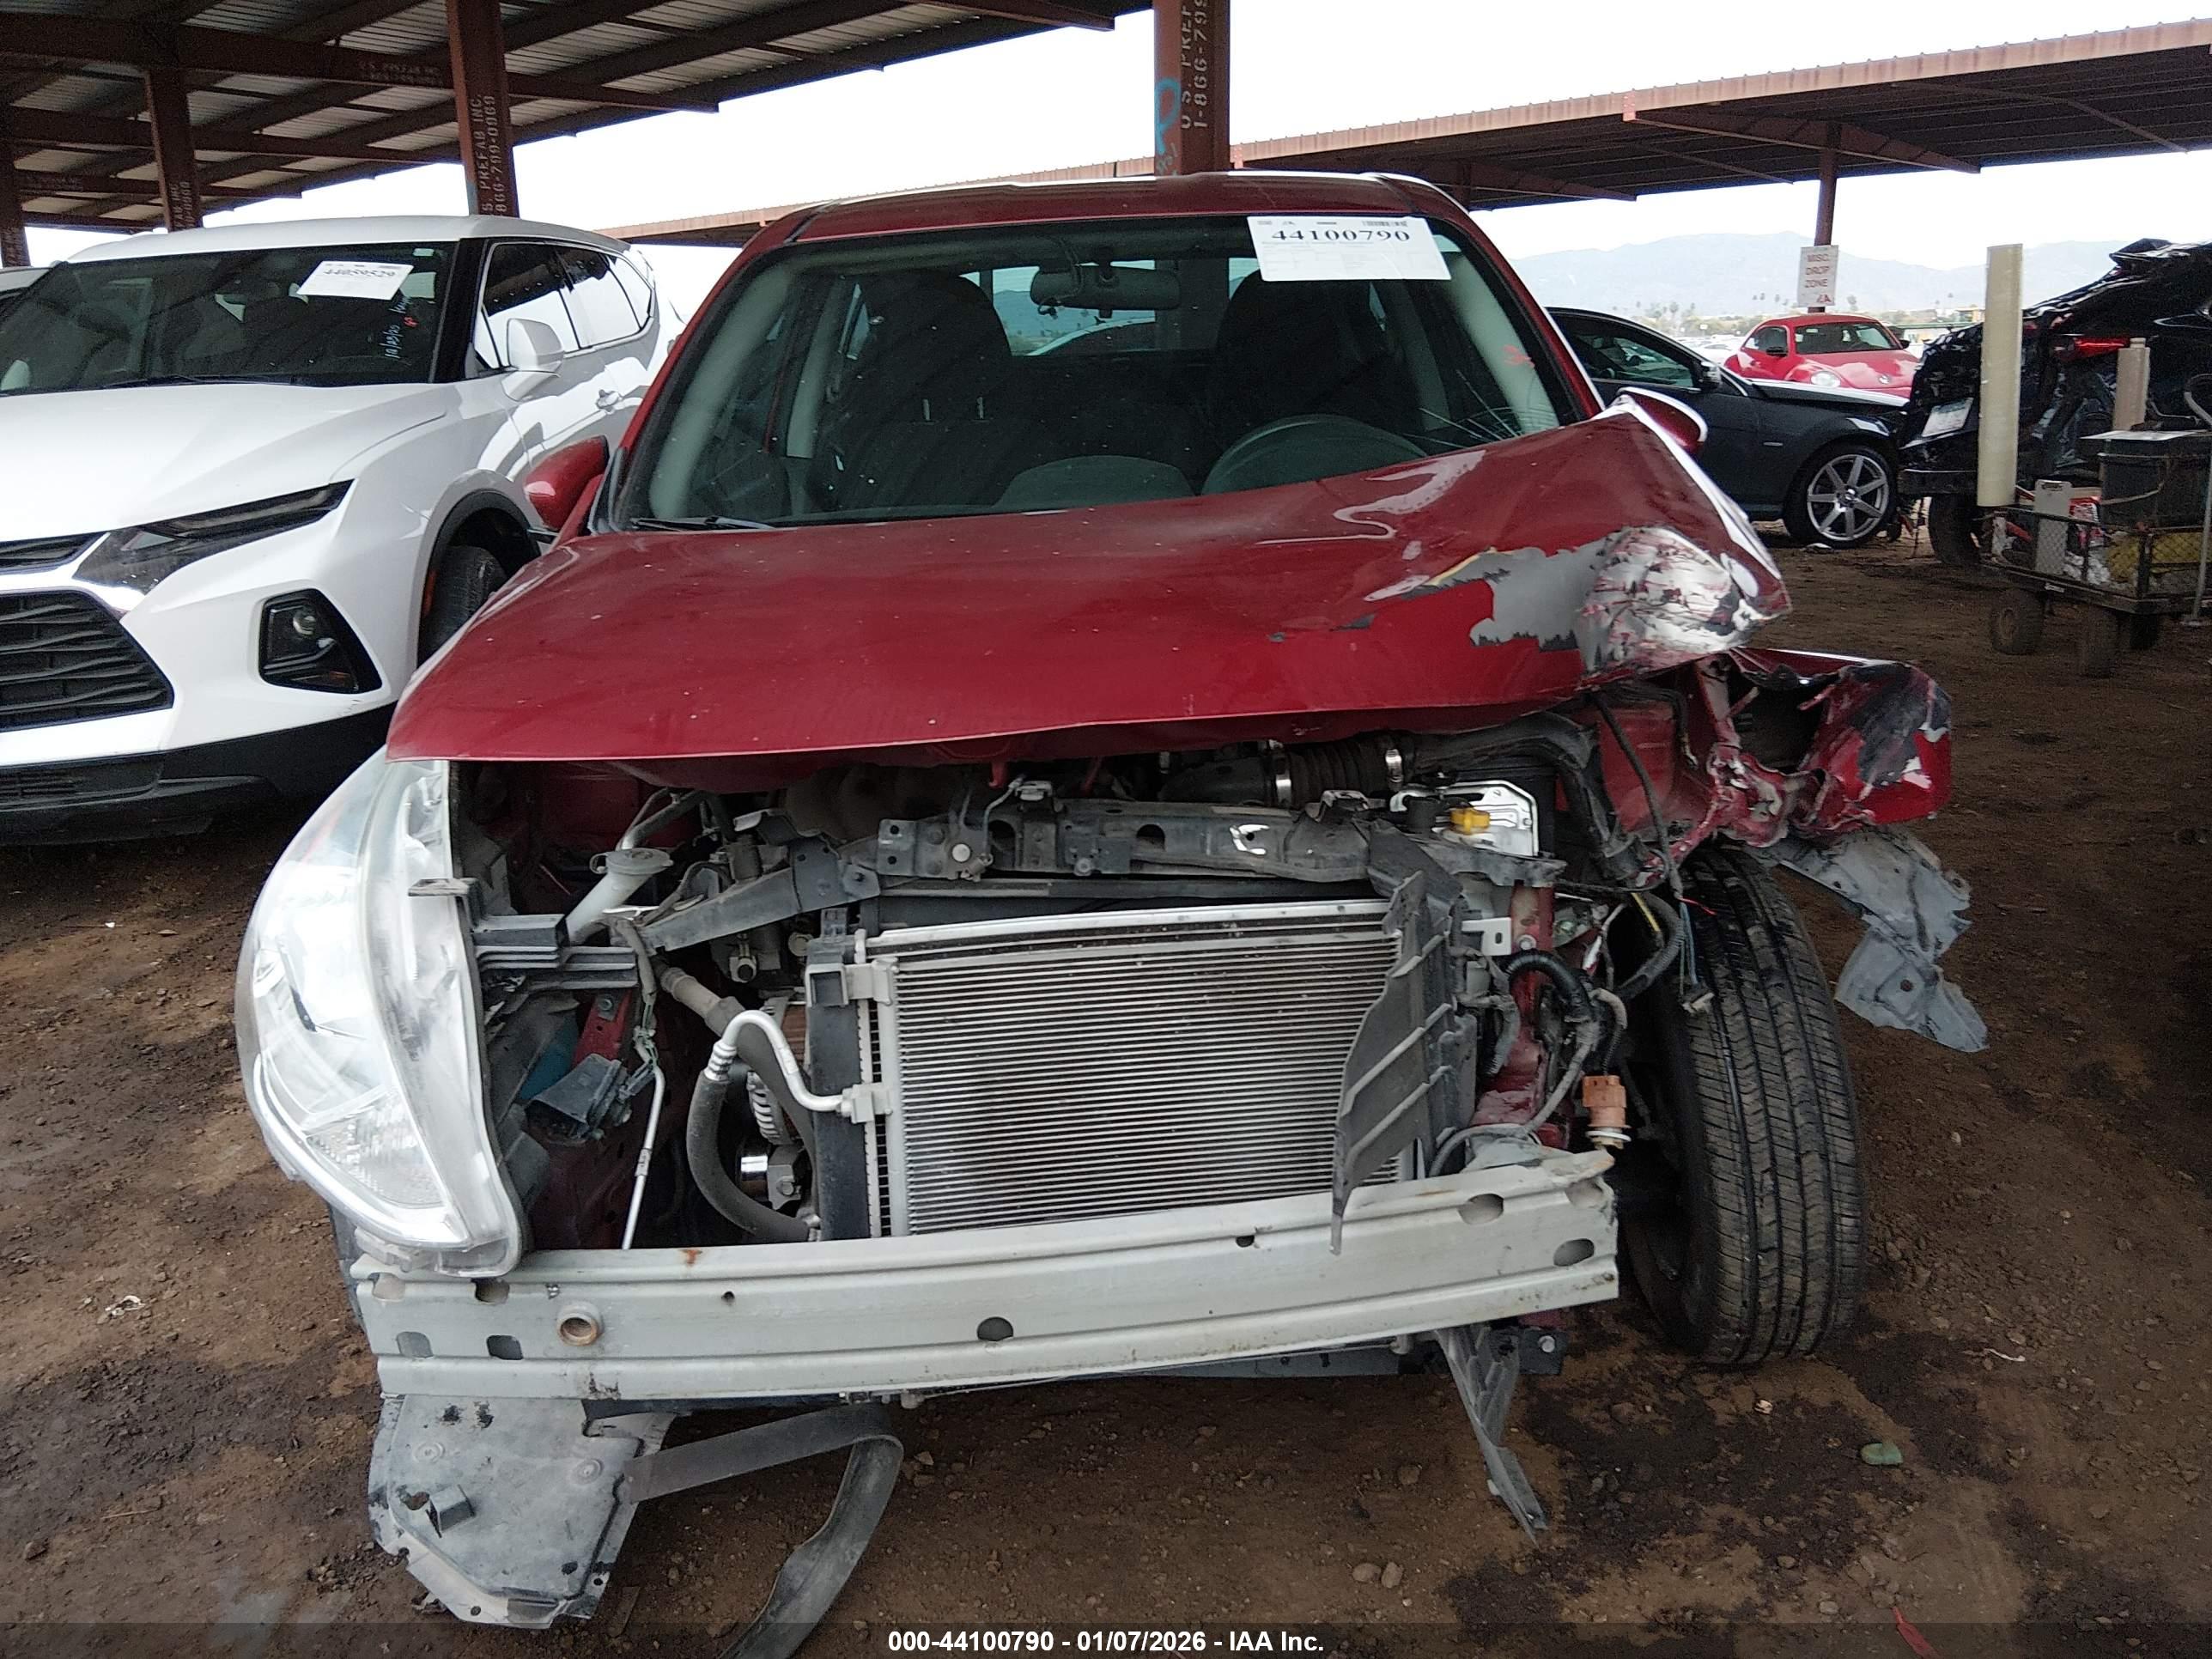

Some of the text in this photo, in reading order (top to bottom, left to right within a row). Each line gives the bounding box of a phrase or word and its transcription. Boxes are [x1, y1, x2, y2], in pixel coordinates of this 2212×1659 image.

[470, 94, 484, 123] INC.
[473, 131, 491, 190] PREFAB
[1272, 229, 1411, 242] 44100790
[1806, 265, 1830, 275] DROP
[1805, 278, 1828, 289] ZONE
